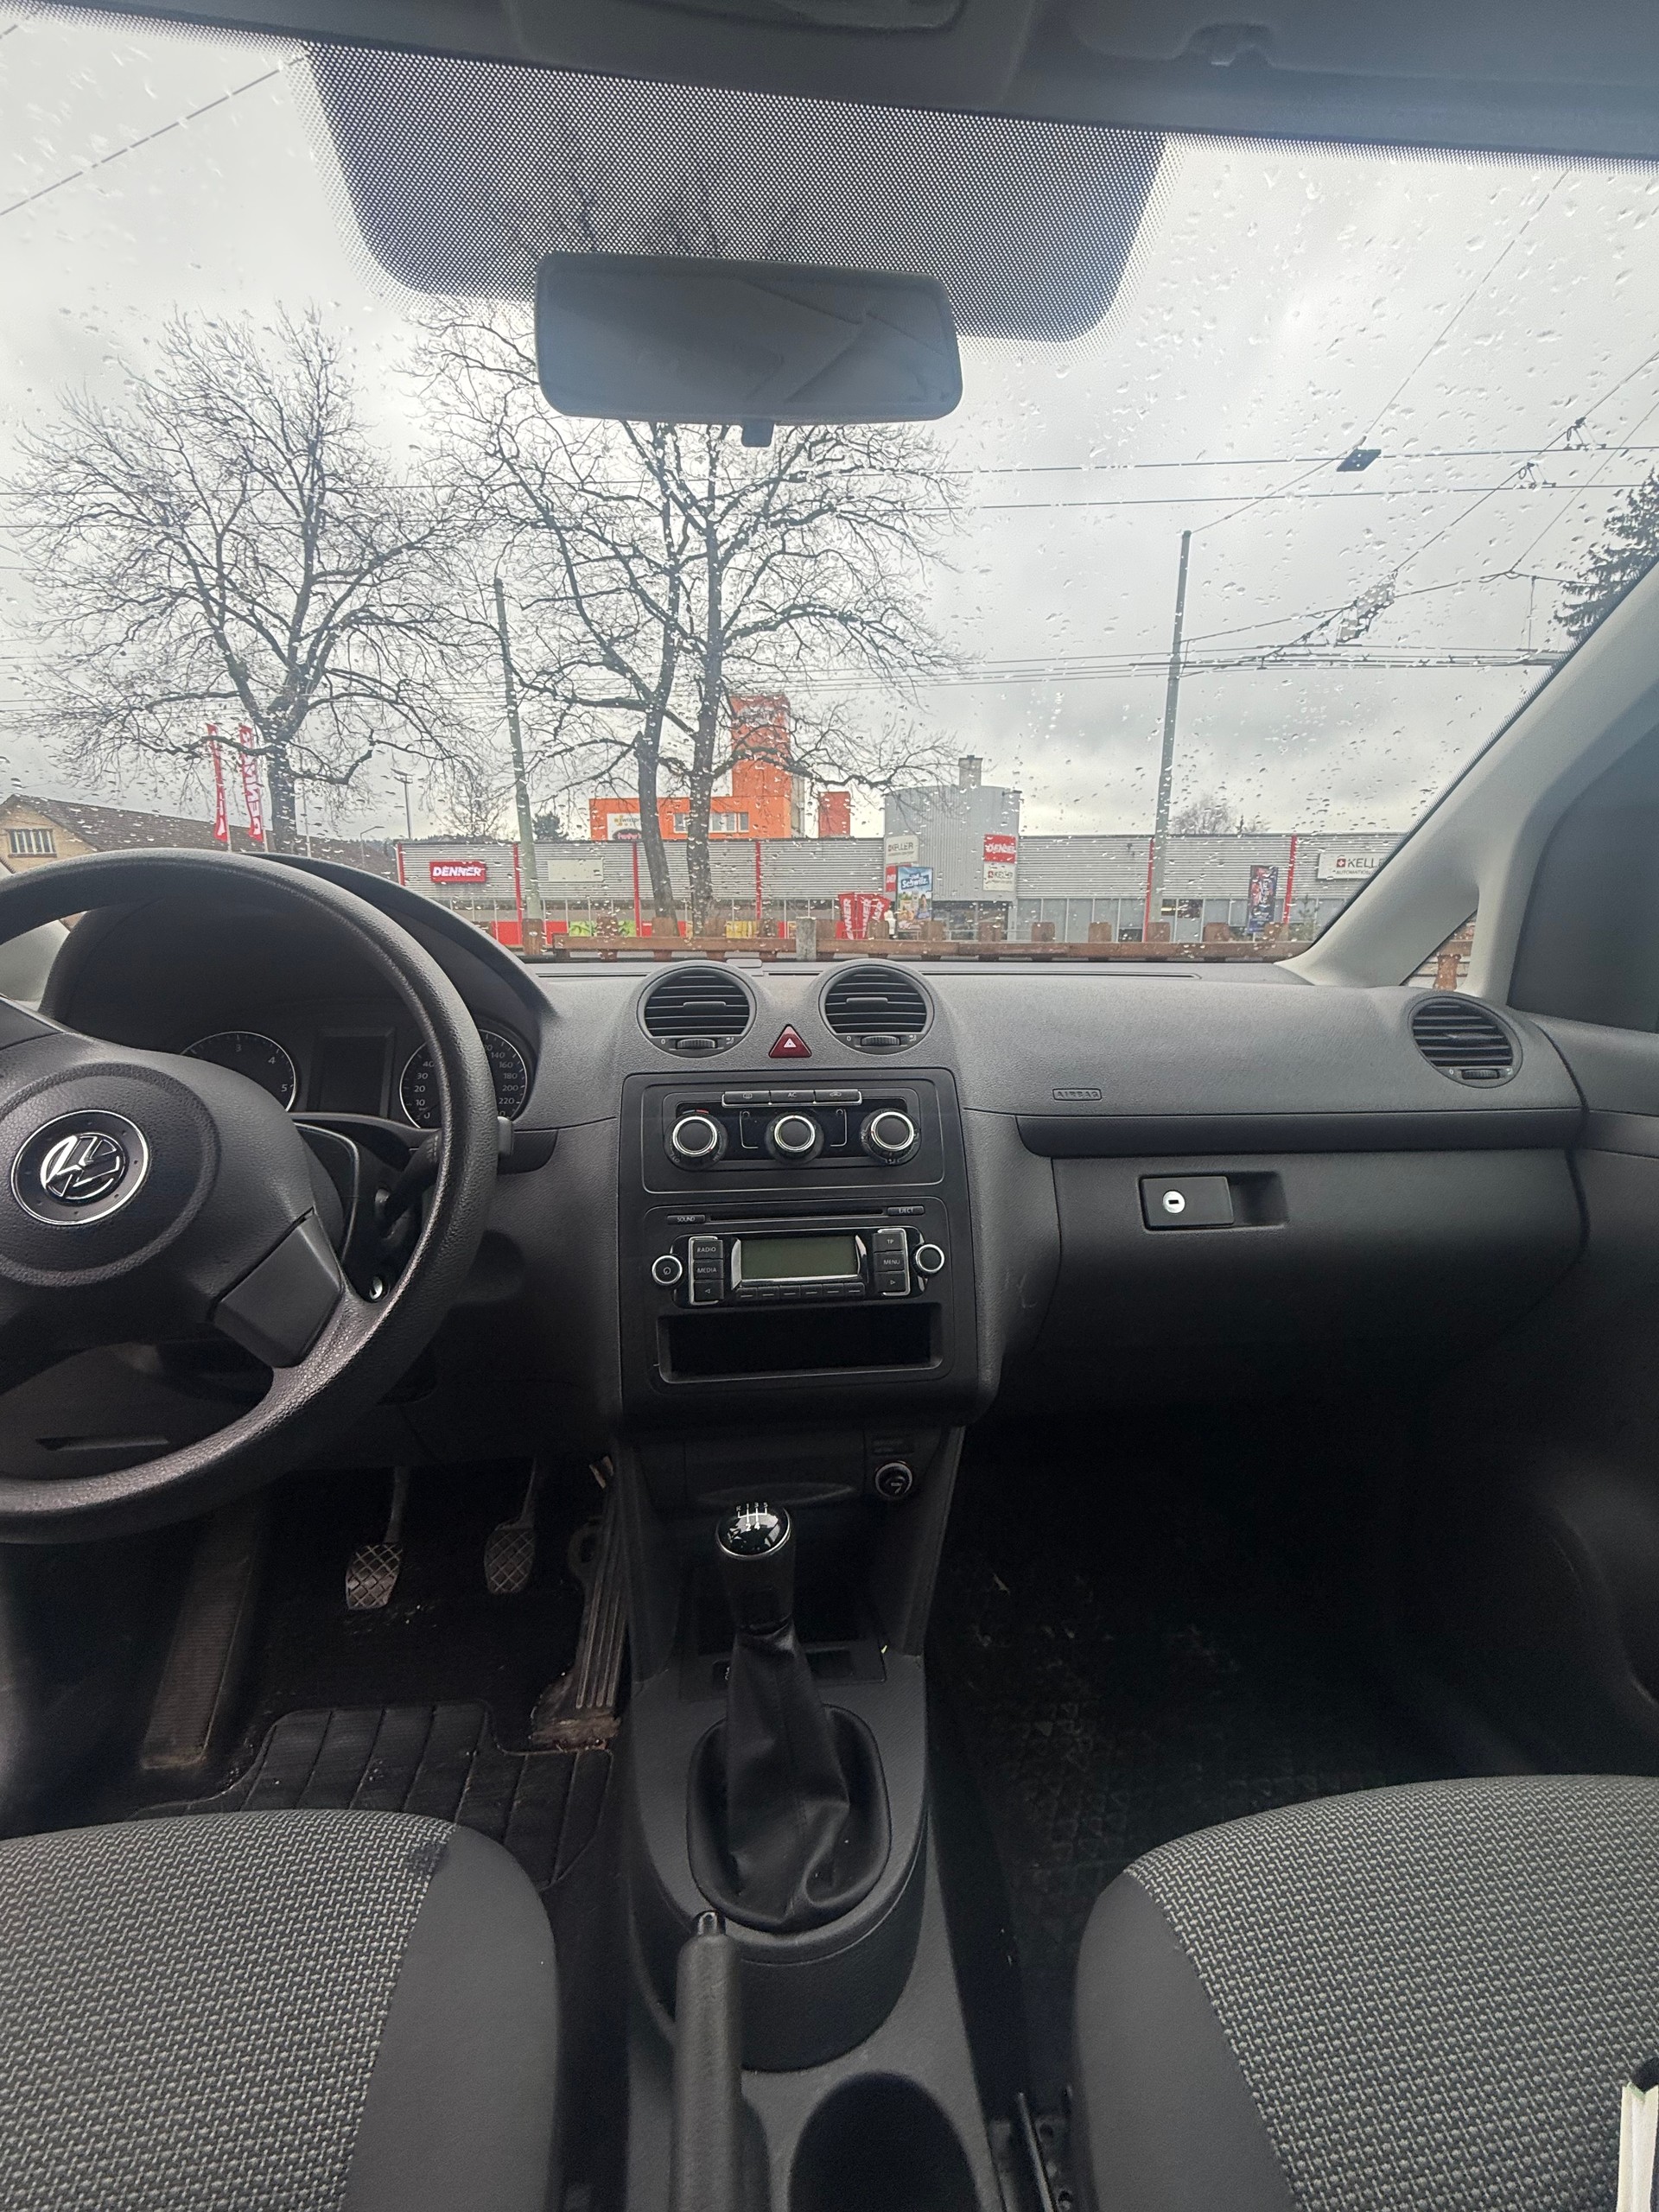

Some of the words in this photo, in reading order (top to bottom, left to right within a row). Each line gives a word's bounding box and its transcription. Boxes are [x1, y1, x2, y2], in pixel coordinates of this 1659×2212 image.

[432, 866, 482, 877] DENNER
[236, 1044, 242, 1052] 3
[268, 1056, 276, 1065] 4
[281, 1084, 288, 1092] 5
[416, 1098, 426, 1107] 10
[754, 1522, 760, 1530] 4
